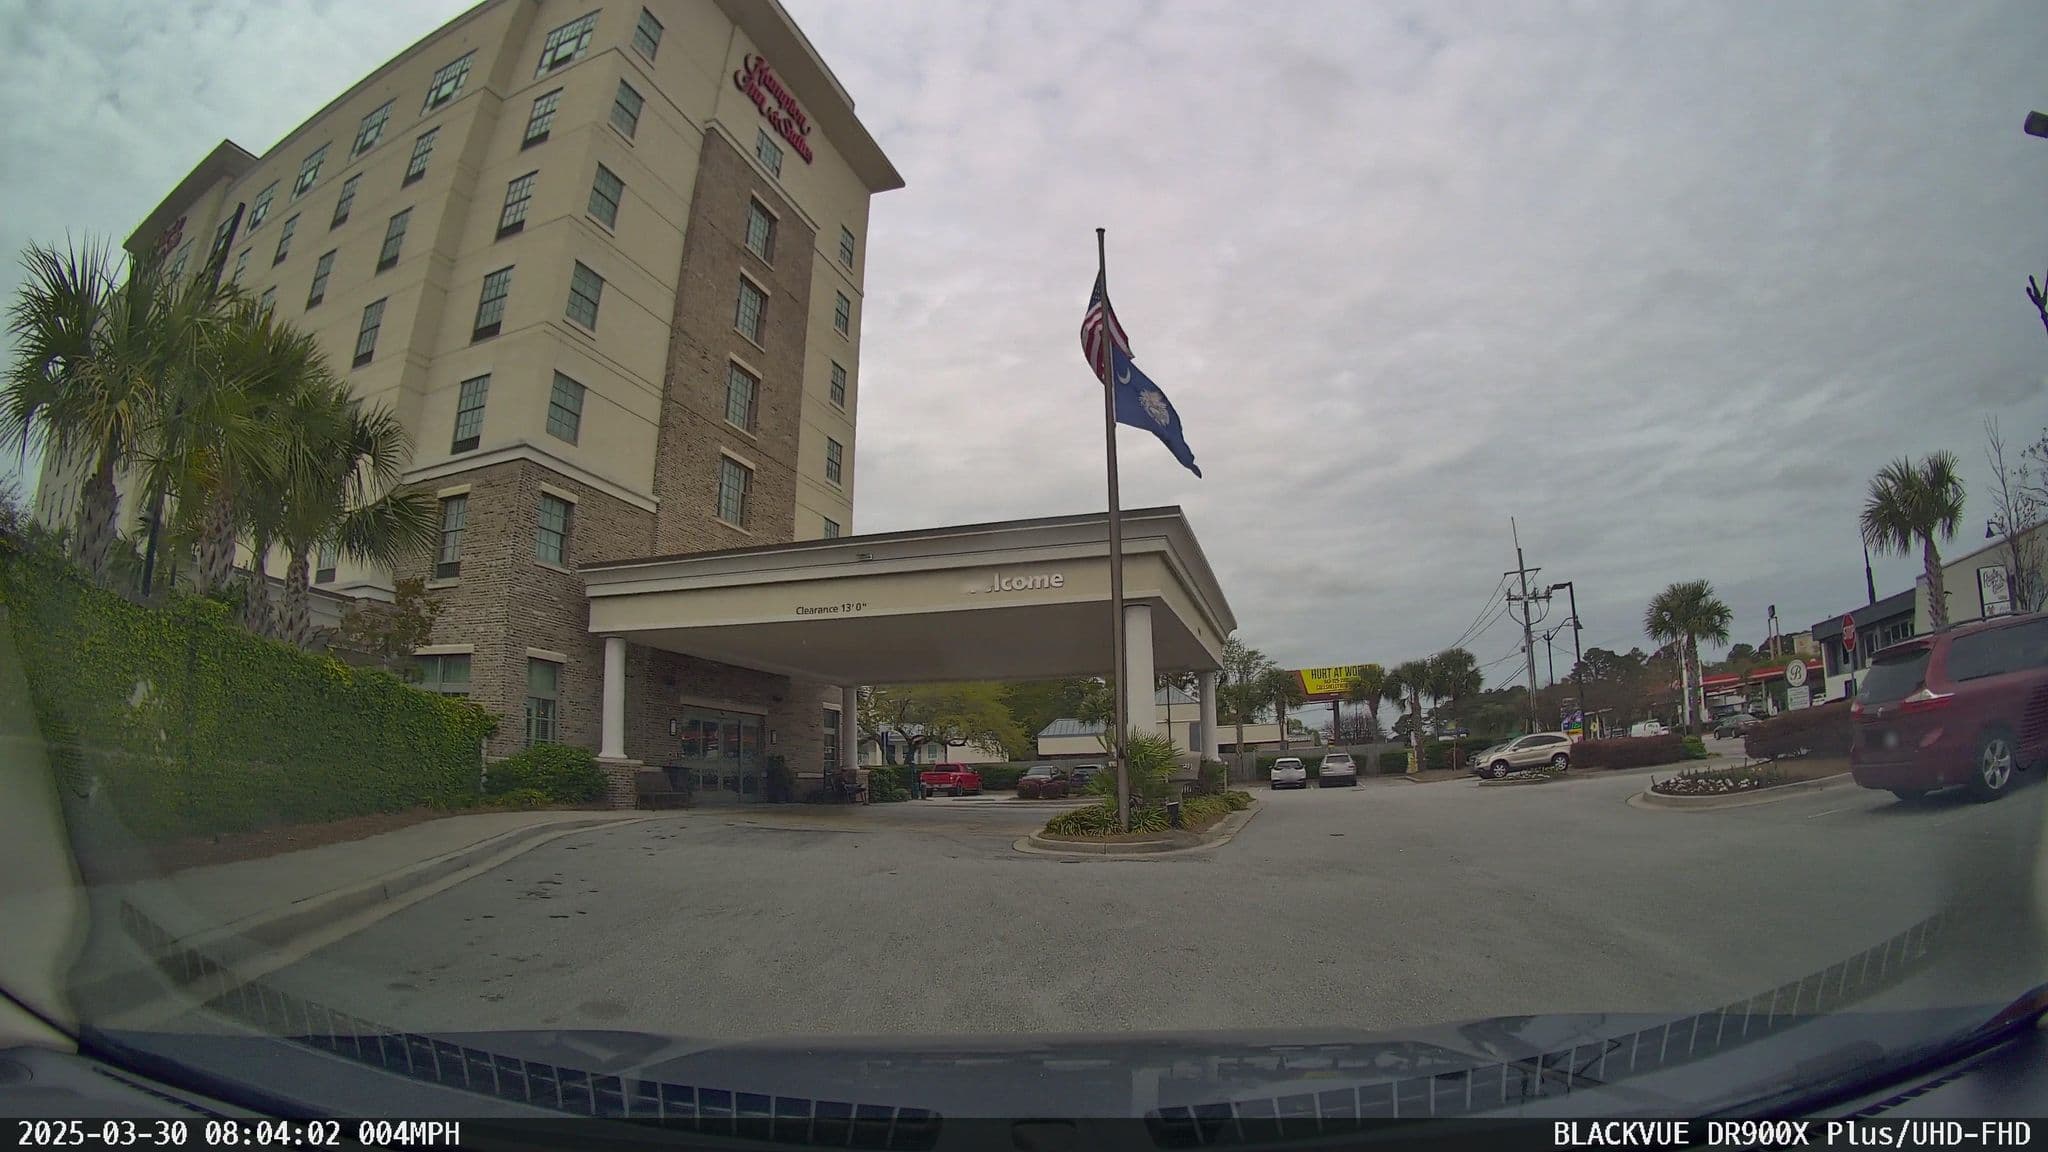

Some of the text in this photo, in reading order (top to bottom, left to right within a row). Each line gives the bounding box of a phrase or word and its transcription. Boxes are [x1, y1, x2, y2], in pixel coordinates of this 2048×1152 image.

[744, 53, 811, 136] Hampton
[796, 606, 839, 615] Clearance
[1311, 667, 1332, 680] HURT
[1333, 666, 1343, 678] AT
